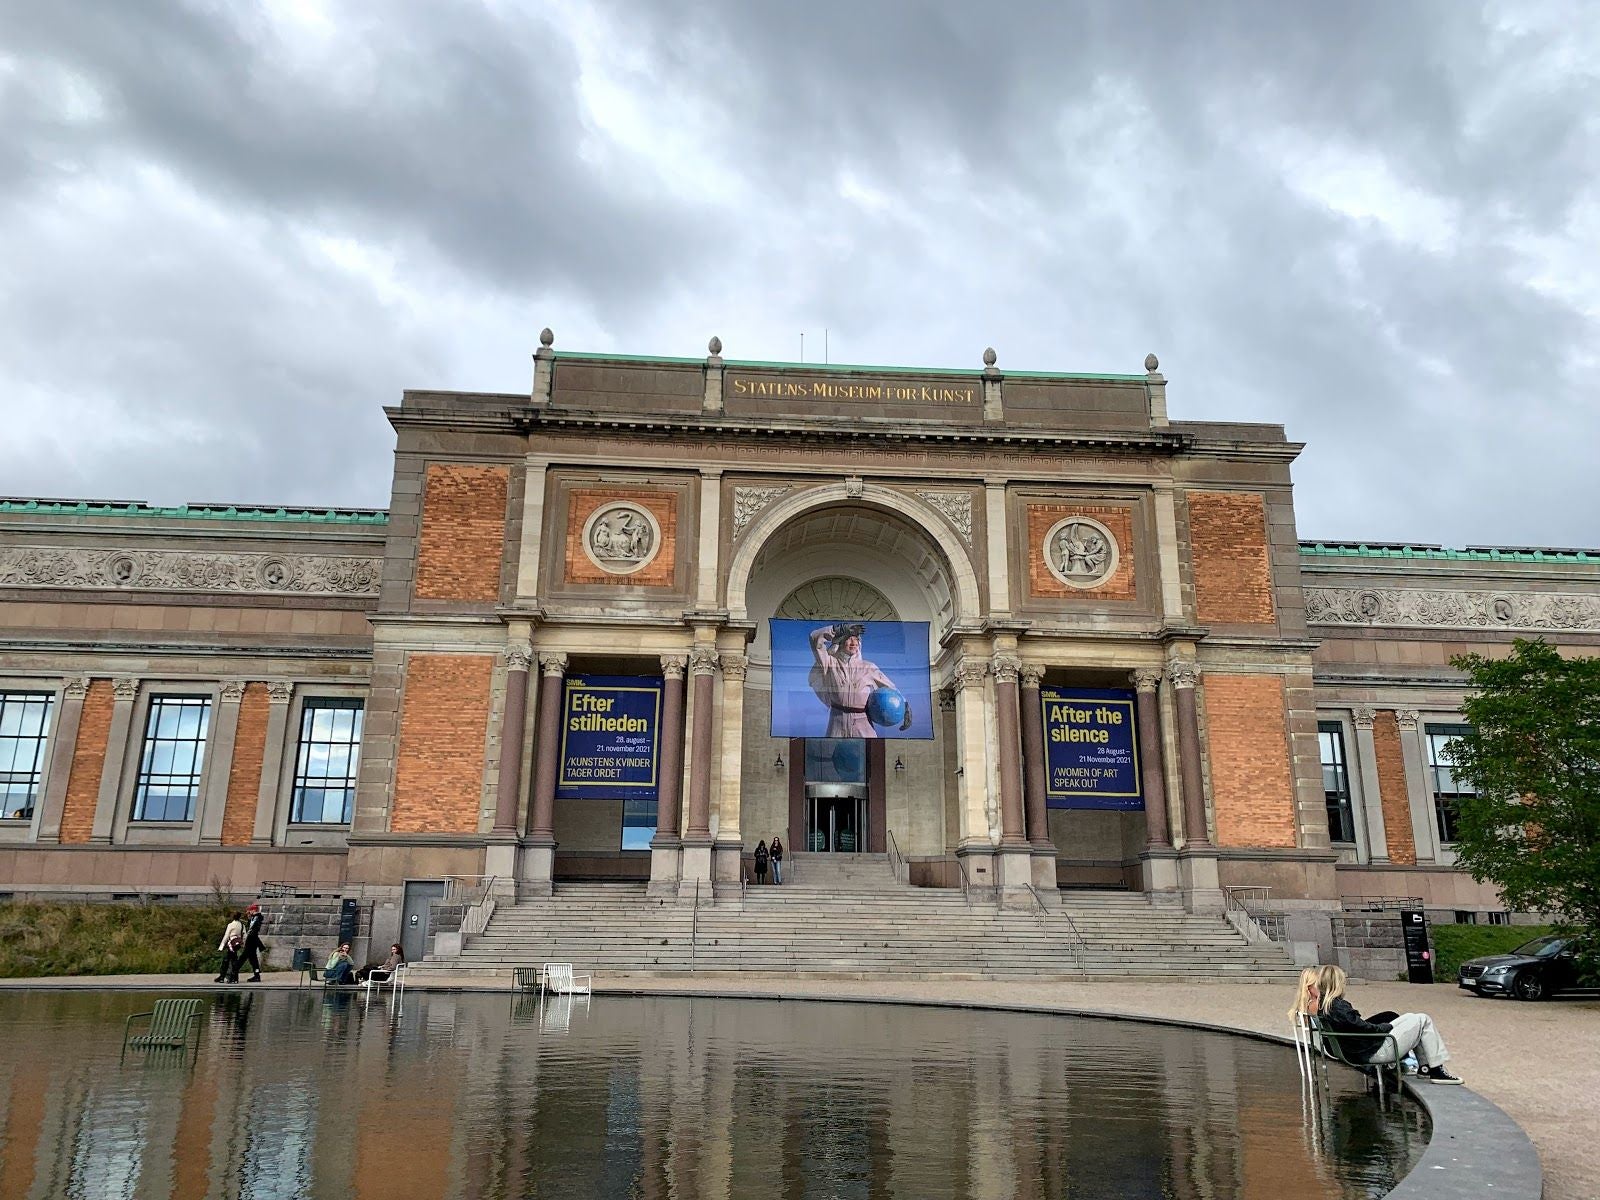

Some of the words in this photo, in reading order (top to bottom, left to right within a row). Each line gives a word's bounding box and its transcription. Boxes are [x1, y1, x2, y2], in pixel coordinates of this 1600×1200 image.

[734, 379, 807, 396] STATENS
[813, 383, 881, 399] MUSEUM
[886, 387, 917, 401] FOR
[921, 386, 974, 403] KUNST
[571, 693, 615, 712] Efter
[1050, 705, 1092, 724] After
[1095, 706, 1122, 725] the
[569, 713, 648, 733] stilheden
[1051, 724, 1109, 744] silence
[625, 737, 645, 745] august
[1105, 748, 1125, 756] August
[615, 757, 650, 768] KVINDER
[1079, 755, 1086, 763] 21
[1086, 756, 1116, 764] November
[1116, 756, 1131, 764] 2021
[566, 768, 592, 777] TAGER
[593, 768, 622, 778] ORDET
[1091, 768, 1102, 777] OF
[1103, 769, 1119, 778] ART
[1054, 778, 1081, 788] SPEAK
[1081, 779, 1098, 788] OUT
